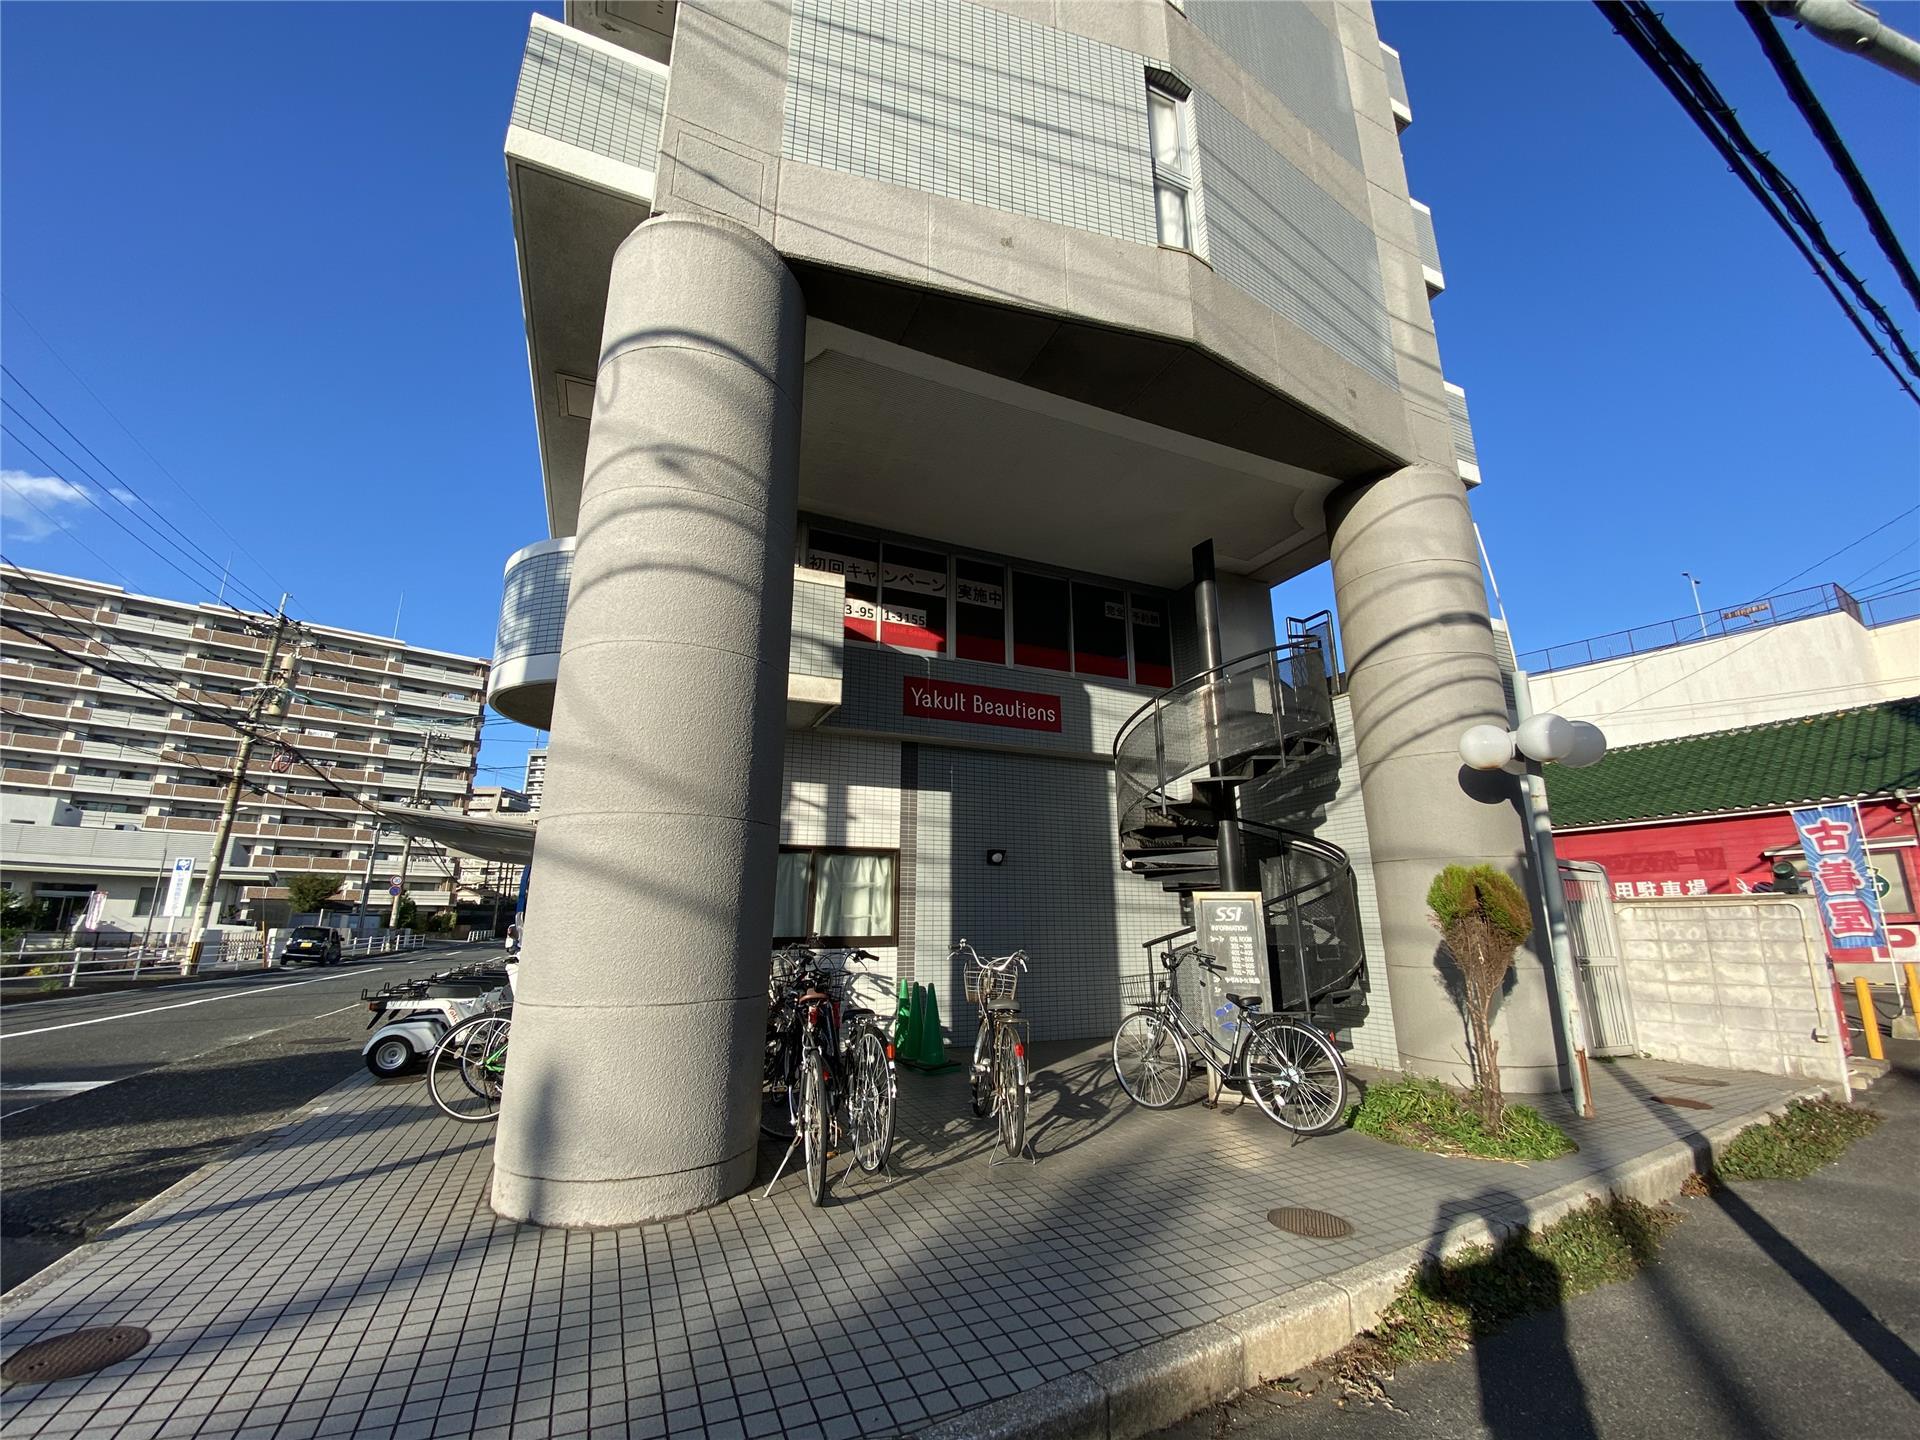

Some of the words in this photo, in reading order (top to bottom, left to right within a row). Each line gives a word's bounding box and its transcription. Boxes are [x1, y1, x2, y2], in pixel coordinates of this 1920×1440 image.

[910, 687, 966, 712] Yakult
[973, 694, 1057, 722] Beautiens
[1801, 817, 1876, 938] 古着屋
[1215, 906, 1242, 922] SSI
